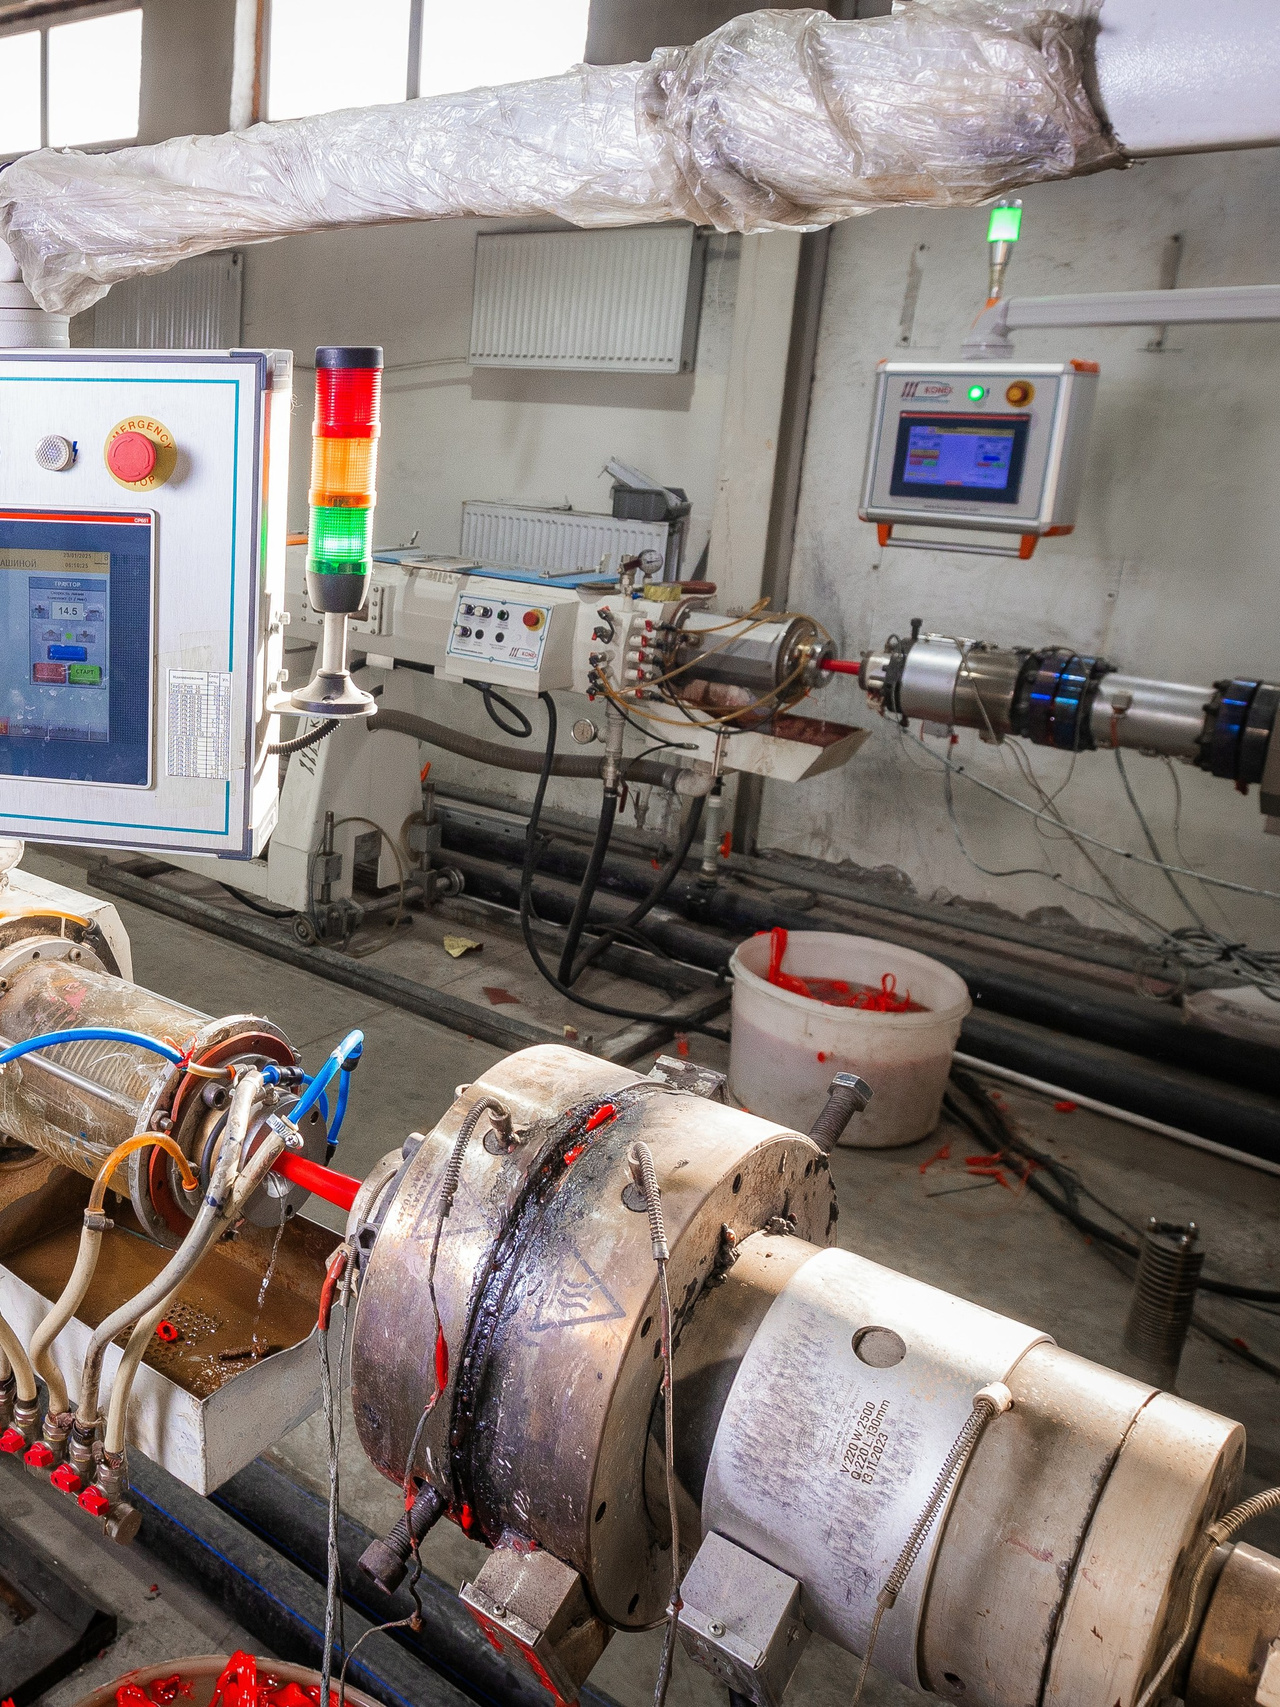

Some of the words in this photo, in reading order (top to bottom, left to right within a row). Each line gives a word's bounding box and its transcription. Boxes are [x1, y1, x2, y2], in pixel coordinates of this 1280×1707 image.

[110, 419, 173, 449] MERGENCY
[58, 607, 78, 615] 14.5
[840, 1442, 859, 1474] V:220
[851, 1401, 876, 1442] W:2500
[863, 1399, 891, 1447] L:130mm
[861, 1432, 889, 1485] 13.11.2023
